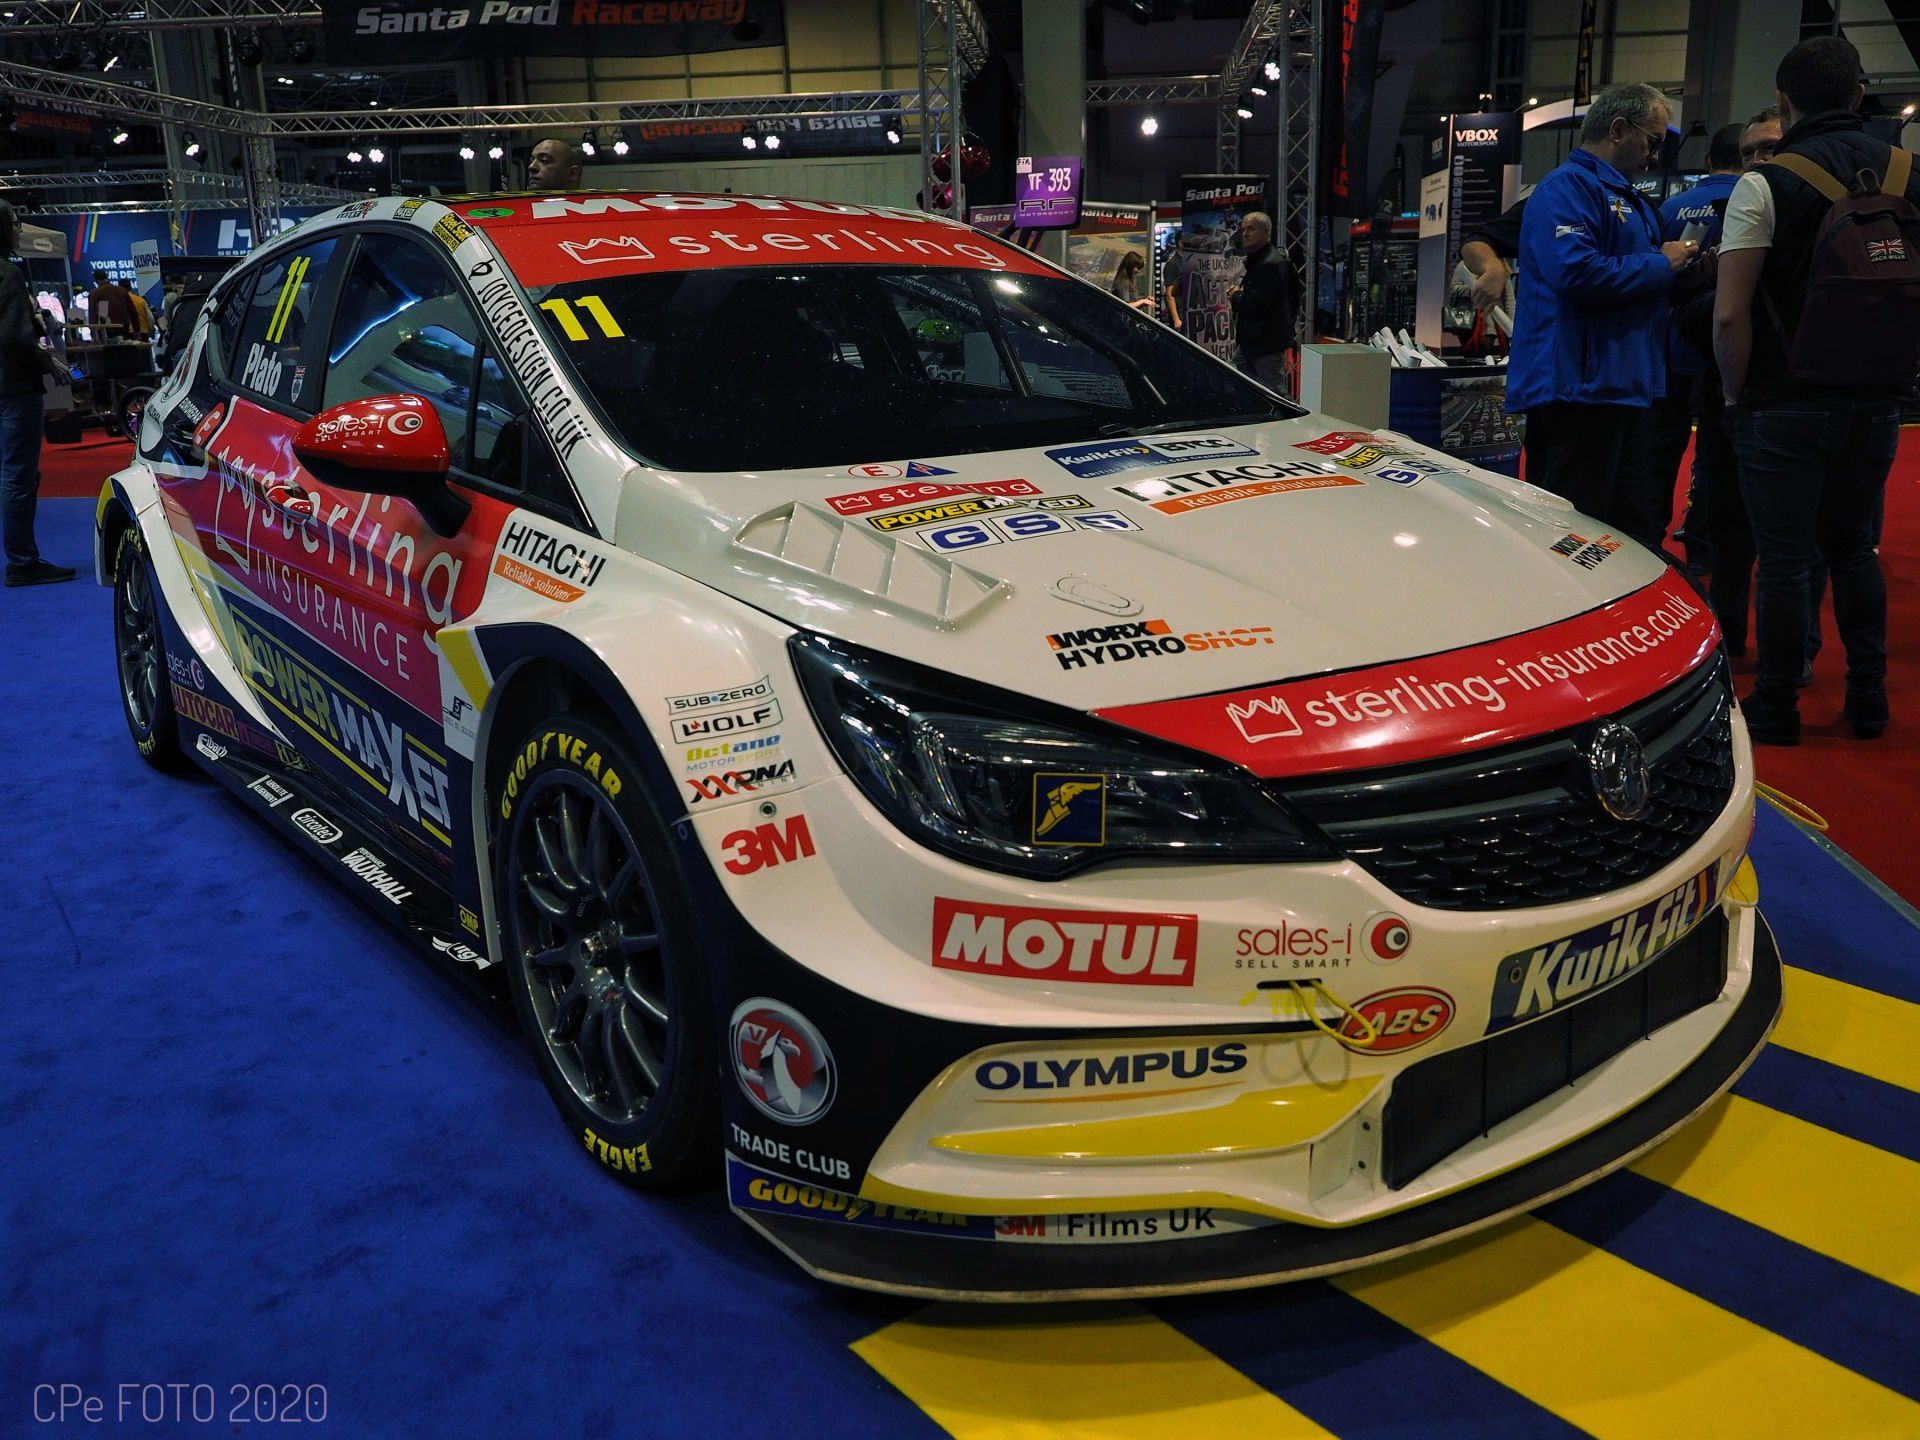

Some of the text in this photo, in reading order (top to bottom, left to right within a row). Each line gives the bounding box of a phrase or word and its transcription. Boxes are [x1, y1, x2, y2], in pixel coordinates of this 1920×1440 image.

[355, 0, 748, 35] Santa Pod Raceway
[1455, 129, 1499, 142] VBOX
[1048, 167, 1072, 192] 393
[1185, 181, 1265, 202] Santa Pod
[974, 212, 1011, 223] Santa
[1081, 209, 1113, 219] anta
[1677, 205, 1714, 221] Kwik
[668, 229, 1006, 268] sterling
[90, 260, 117, 270] YOUR
[265, 255, 312, 344] 11
[538, 295, 626, 342] 11
[241, 342, 283, 398] Plato
[316, 414, 386, 437] sales-i
[344, 429, 382, 438] SMART
[868, 465, 890, 477] E
[1180, 477, 1344, 509] Reliable solutions
[881, 502, 983, 529] POWER
[260, 464, 463, 657] sterling
[502, 522, 606, 587] HITACHI
[503, 561, 572, 601] Reliable solutions
[256, 548, 411, 681] INSURANCE
[1051, 621, 1155, 650] WORX
[1304, 591, 1701, 728] sterling-insurance.co.uk
[682, 707, 771, 737] WOLF
[198, 733, 229, 758] Eibach
[685, 734, 781, 763] Octane
[685, 748, 781, 773] MOTORSPORT
[501, 731, 623, 820] GOODYEAR
[721, 814, 817, 876] 3M
[340, 849, 414, 906] VAUXHALL
[940, 911, 1188, 977] MOTUL
[1236, 919, 1352, 957] sales-i
[1235, 958, 1352, 969] SELL SMART
[975, 1042, 1248, 1090] OLYMPUS
[584, 1127, 654, 1174] EAGLE
[730, 1122, 851, 1180] TRADE CLUB
[995, 1213, 1046, 1238] 3M
[1067, 1207, 1217, 1239] Films UK
